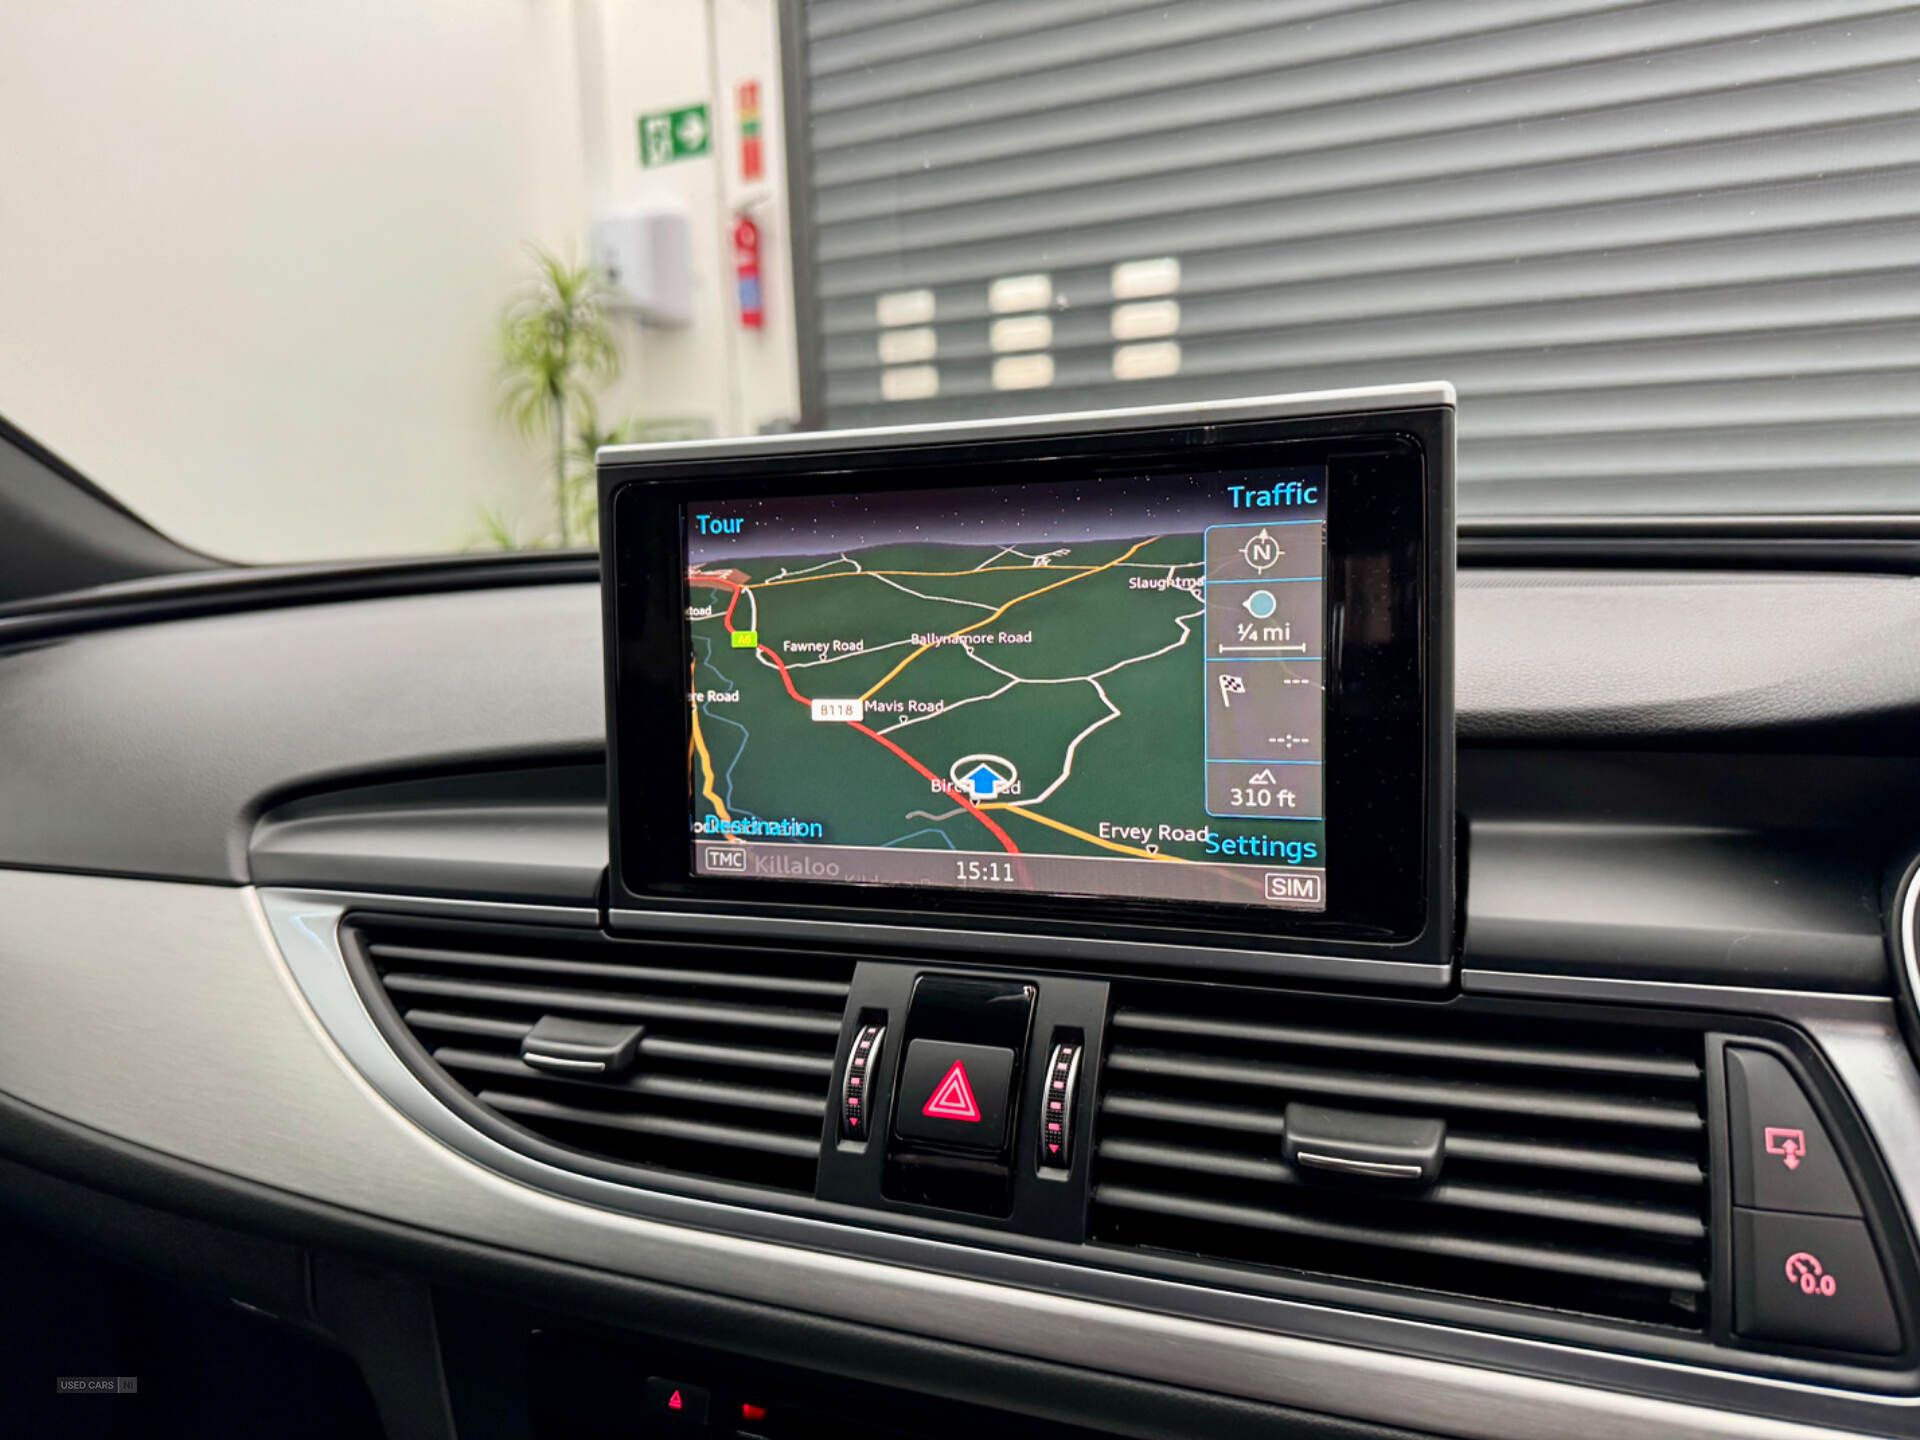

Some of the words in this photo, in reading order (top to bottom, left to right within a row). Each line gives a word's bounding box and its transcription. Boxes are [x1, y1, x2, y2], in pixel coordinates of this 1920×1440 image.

[1227, 482, 1318, 508] Traffic
[696, 515, 744, 535] Tour
[1253, 545, 1271, 561] N
[911, 633, 994, 647] Ballynamore
[998, 631, 1033, 643] Road
[1263, 622, 1291, 641] mi
[783, 641, 829, 654] Fawney
[833, 639, 864, 651] Road
[707, 690, 739, 702] Road
[820, 704, 854, 716] B118
[864, 700, 904, 712] Mavis
[908, 699, 944, 713] Road
[1230, 789, 1271, 807] 310
[1277, 789, 1296, 808] ft
[705, 814, 823, 838] Destination
[1099, 822, 1153, 844] Ervey
[1158, 824, 1209, 842] Road
[1205, 832, 1318, 864] Settings
[709, 851, 743, 867] TMC
[755, 855, 840, 876] Killaloo
[956, 861, 1014, 882] 15:11
[1271, 878, 1313, 897] SIM
